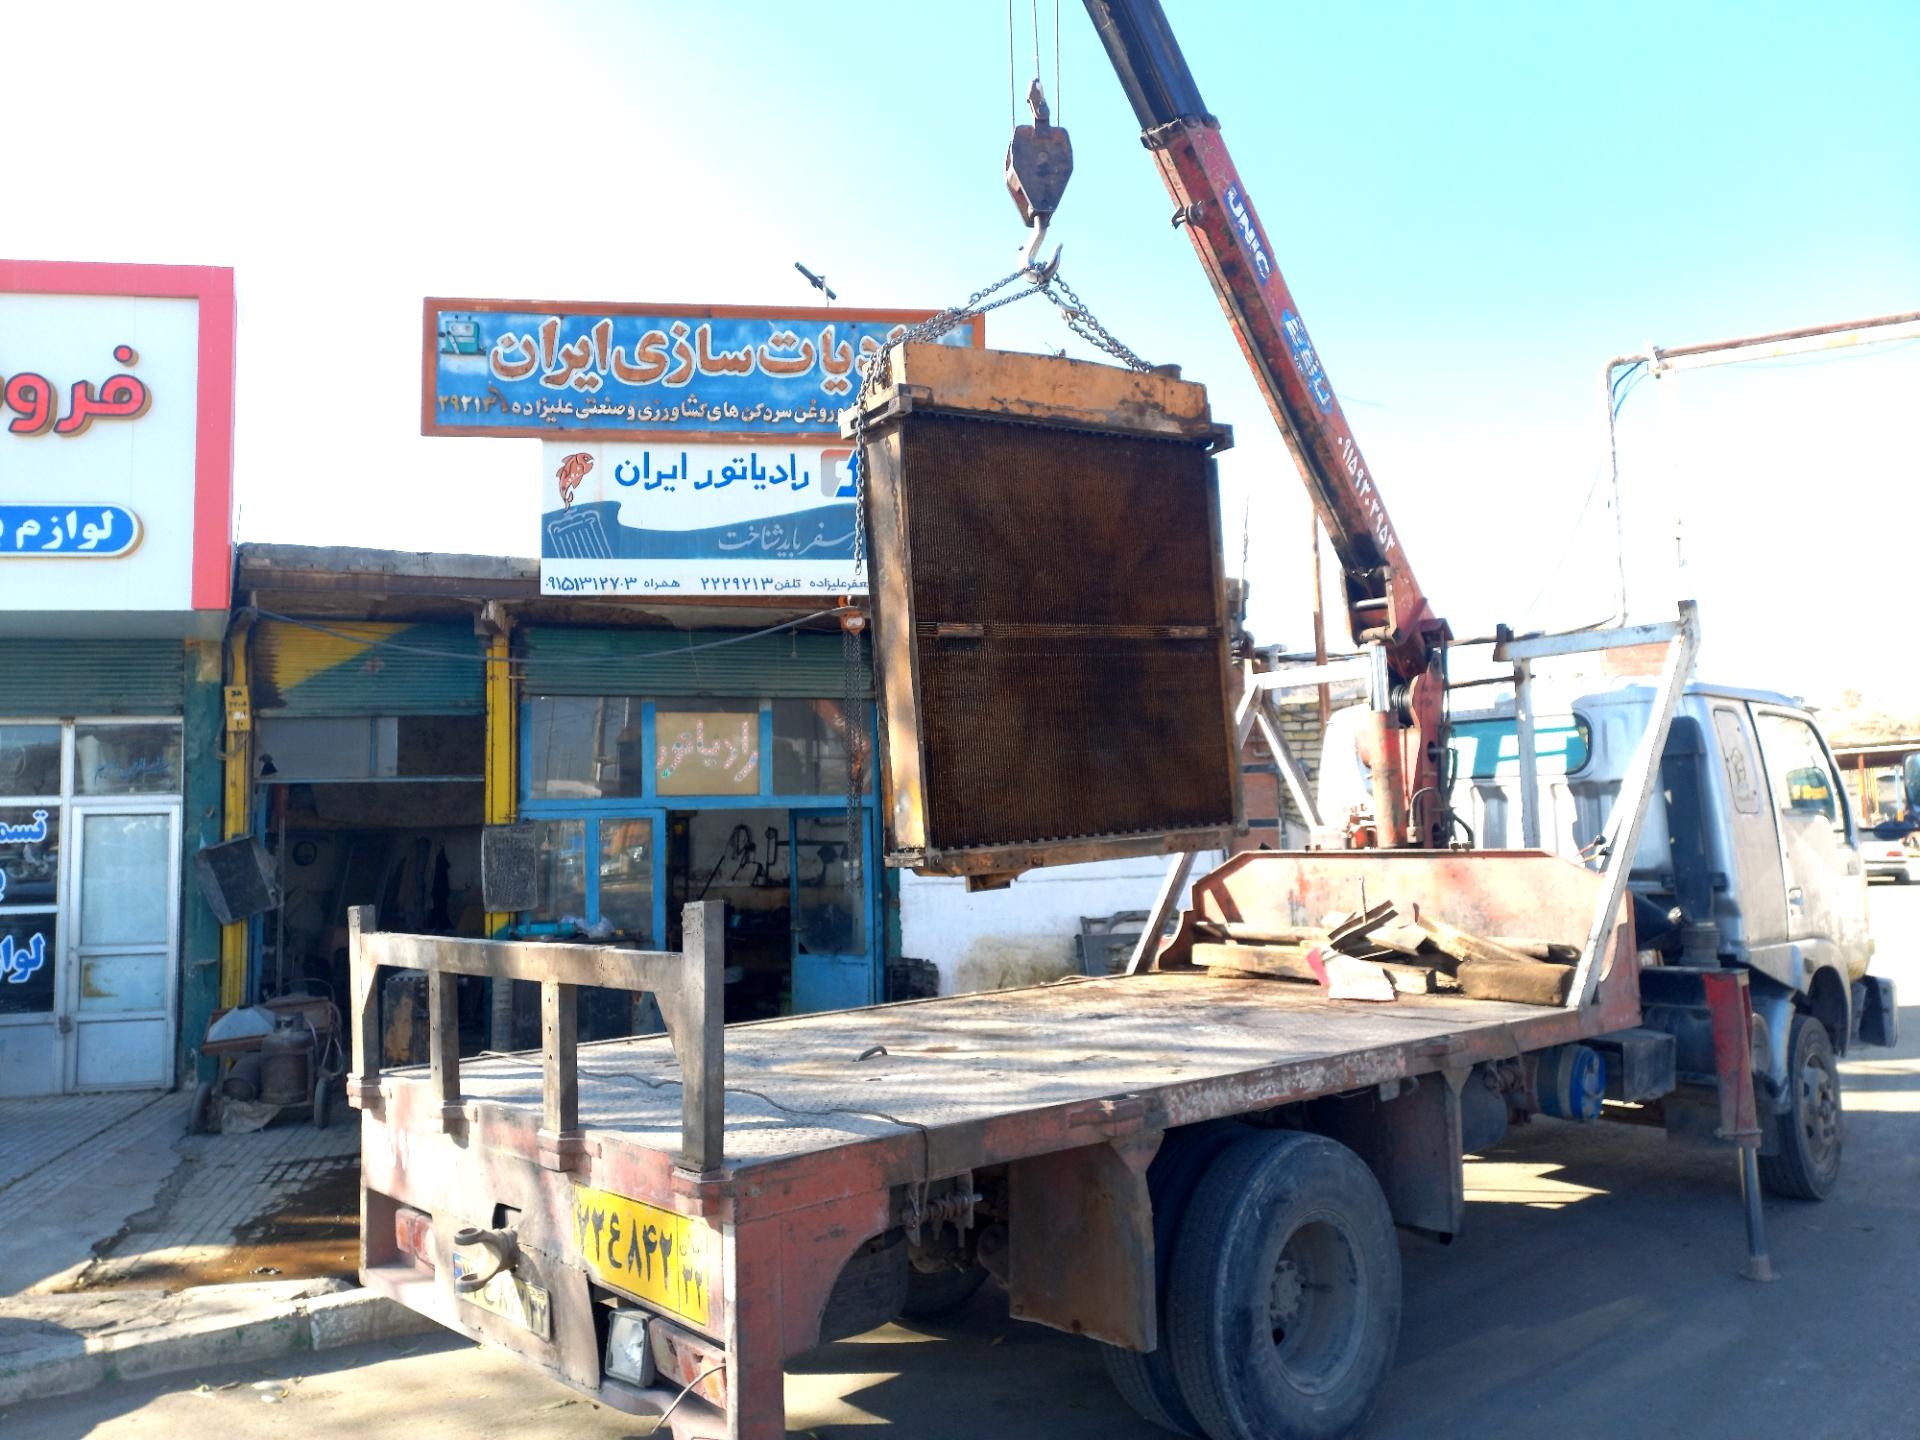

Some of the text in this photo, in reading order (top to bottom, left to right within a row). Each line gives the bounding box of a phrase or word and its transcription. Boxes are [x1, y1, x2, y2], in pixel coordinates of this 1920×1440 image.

[1227, 187, 1271, 279] UNIC
[490, 316, 613, 393] ایران
[610, 320, 755, 388] سازی
[0, 344, 151, 435] فرو
[614, 451, 810, 493] رادیاتور ایران
[15, 508, 116, 550] لوازم
[643, 577, 681, 591] همراه
[700, 576, 773, 591] ۲۲۲۹۲۱۳
[774, 579, 801, 590] تلفن
[0, 810, 48, 843] تسم
[0, 932, 46, 983] لوا
